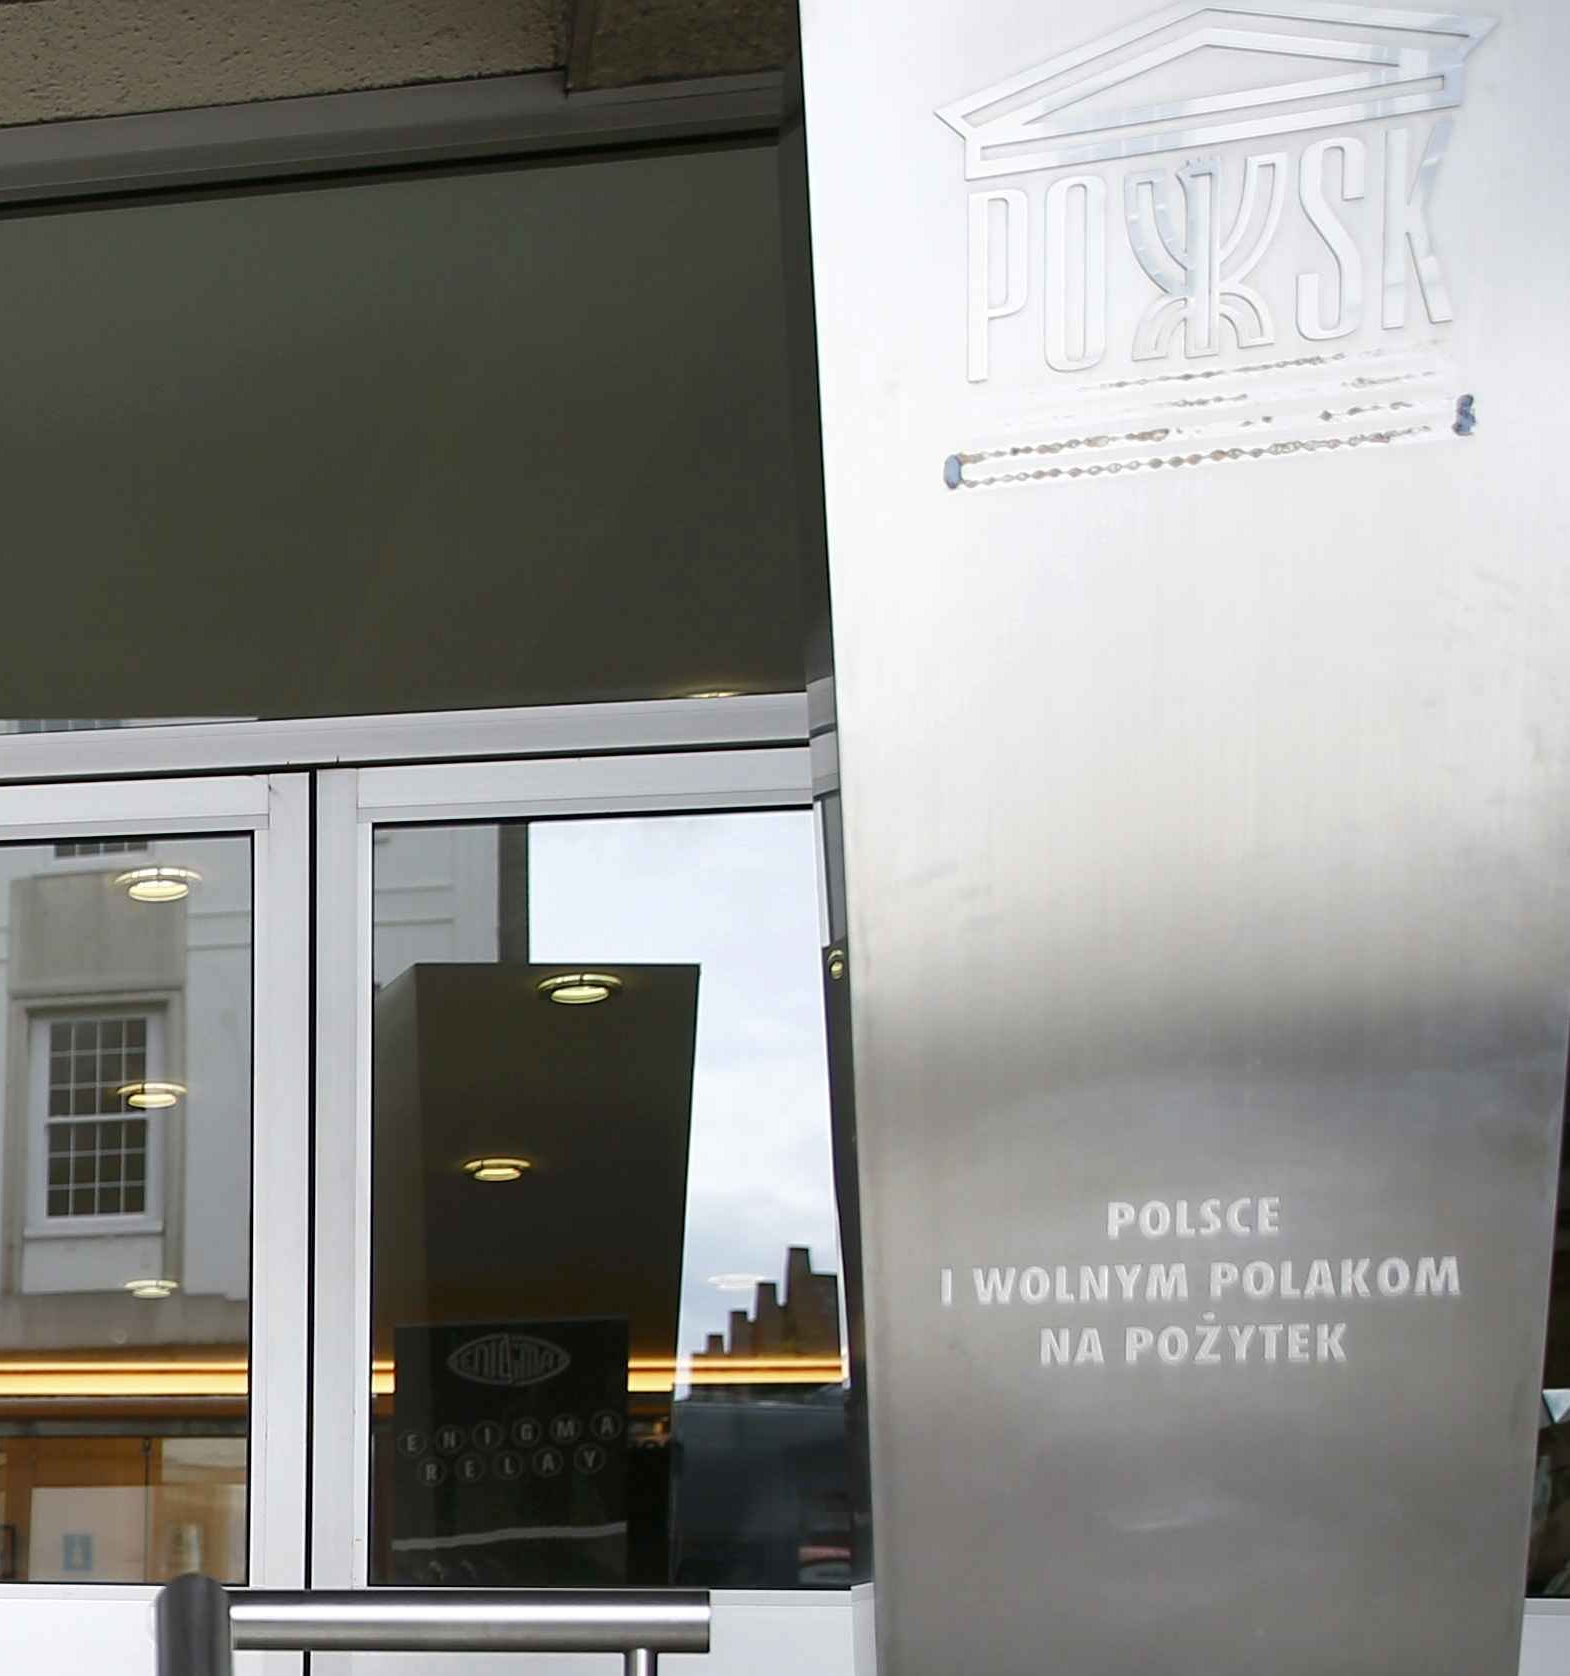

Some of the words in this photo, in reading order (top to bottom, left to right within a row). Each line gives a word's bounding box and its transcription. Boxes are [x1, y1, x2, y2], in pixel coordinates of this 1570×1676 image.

[1105, 1195, 1283, 1241] POLSCE
[940, 1267, 953, 1306] I
[973, 1262, 1190, 1306] WOLNYM
[1209, 1255, 1462, 1301] POLAKOM
[1040, 1326, 1105, 1367] NA
[1125, 1311, 1348, 1366] POŻYTEK
[404, 1414, 616, 1451] ENIGMA
[424, 1449, 600, 1481] RELAY
